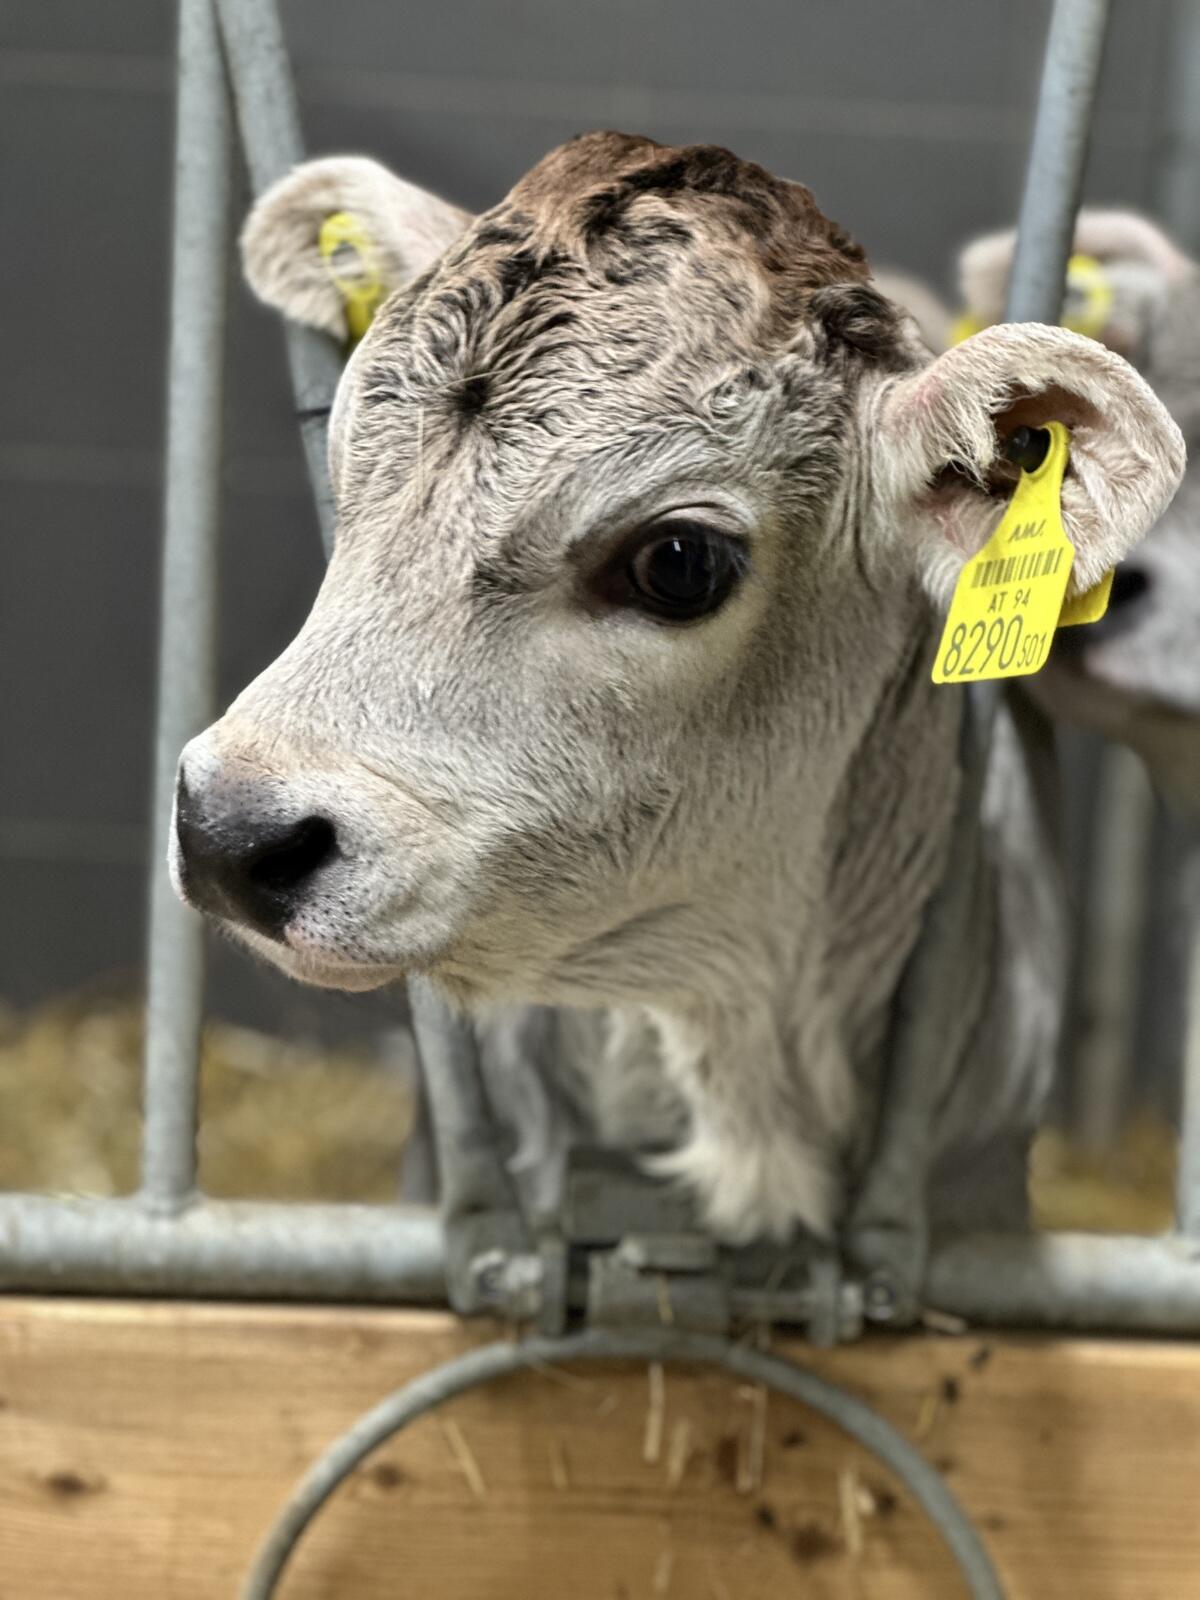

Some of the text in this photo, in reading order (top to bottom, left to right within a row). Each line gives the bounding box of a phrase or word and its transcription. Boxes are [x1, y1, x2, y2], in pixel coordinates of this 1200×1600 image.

[987, 587, 1031, 613] AT 94
[942, 614, 1047, 677] 8290 501
